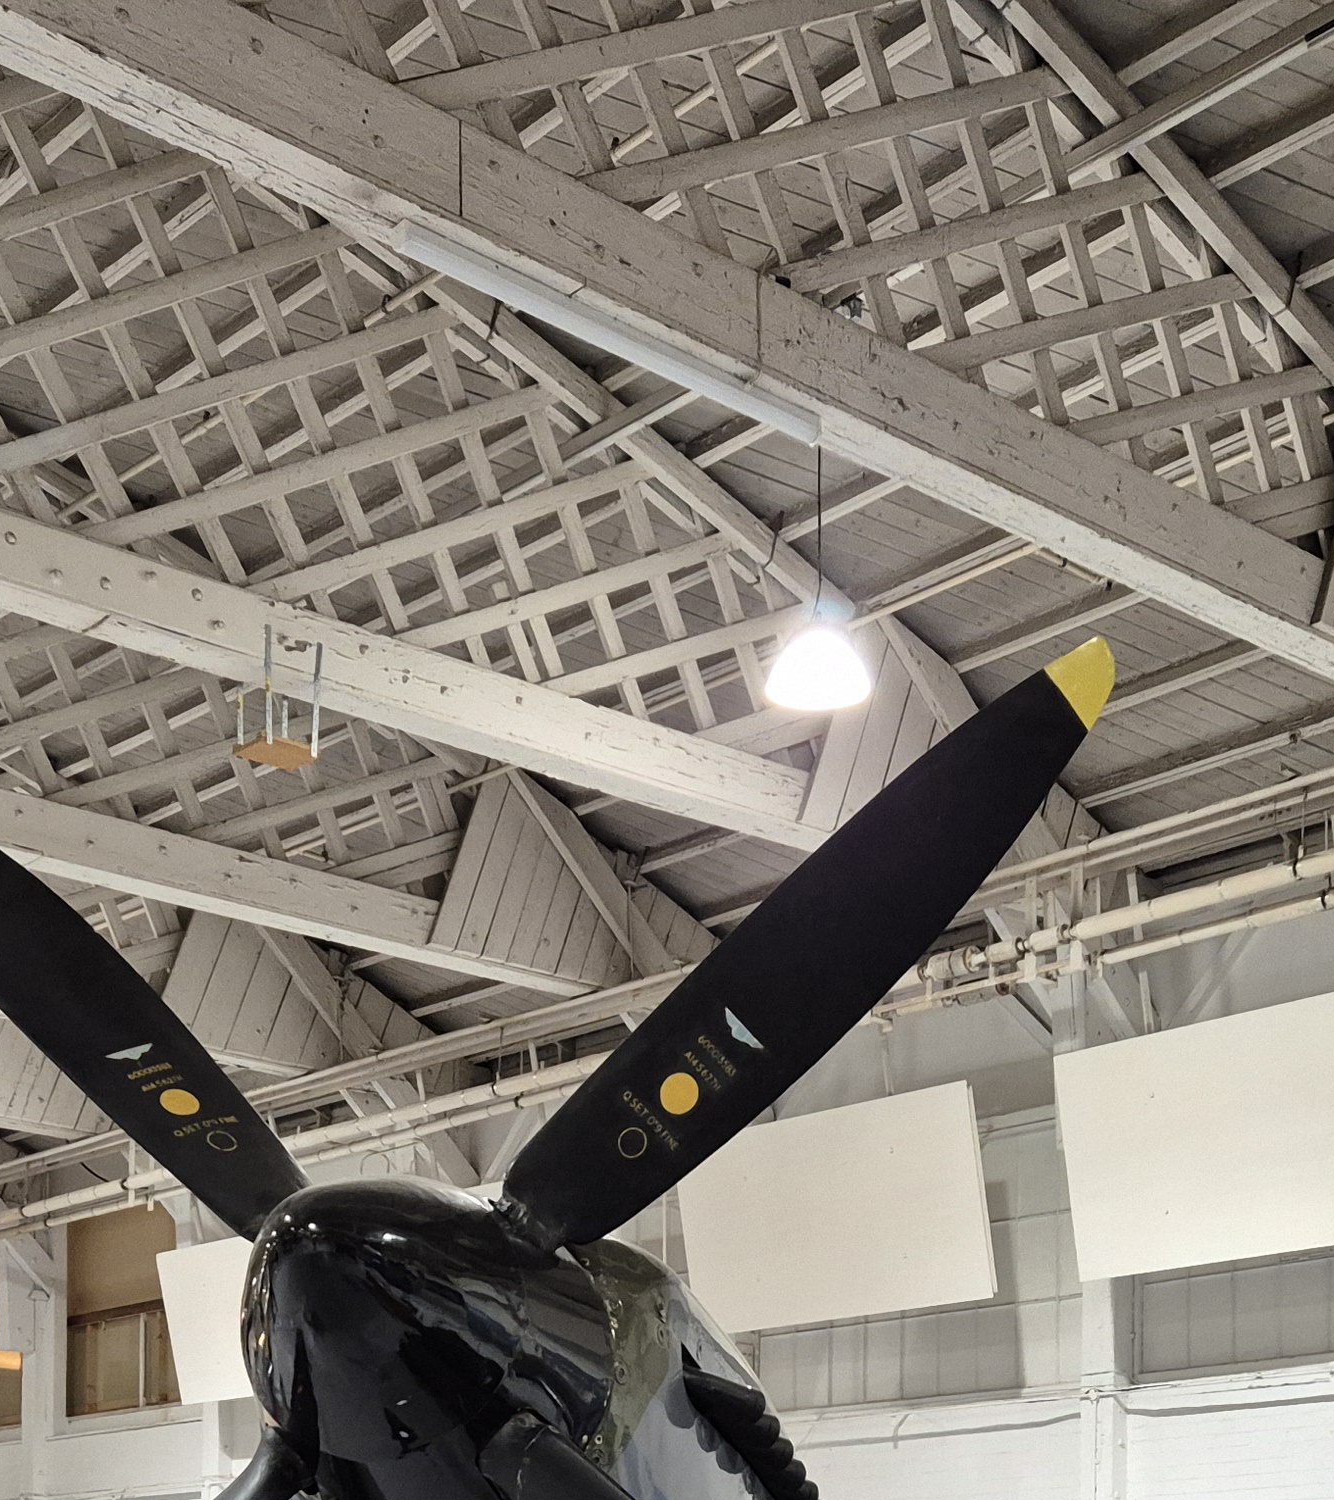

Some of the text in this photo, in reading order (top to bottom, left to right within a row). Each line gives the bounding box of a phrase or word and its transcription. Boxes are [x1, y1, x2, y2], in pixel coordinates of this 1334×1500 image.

[623, 1091, 631, 1103] Q
[630, 1099, 648, 1118] SET
[660, 1128, 680, 1151] FINE
